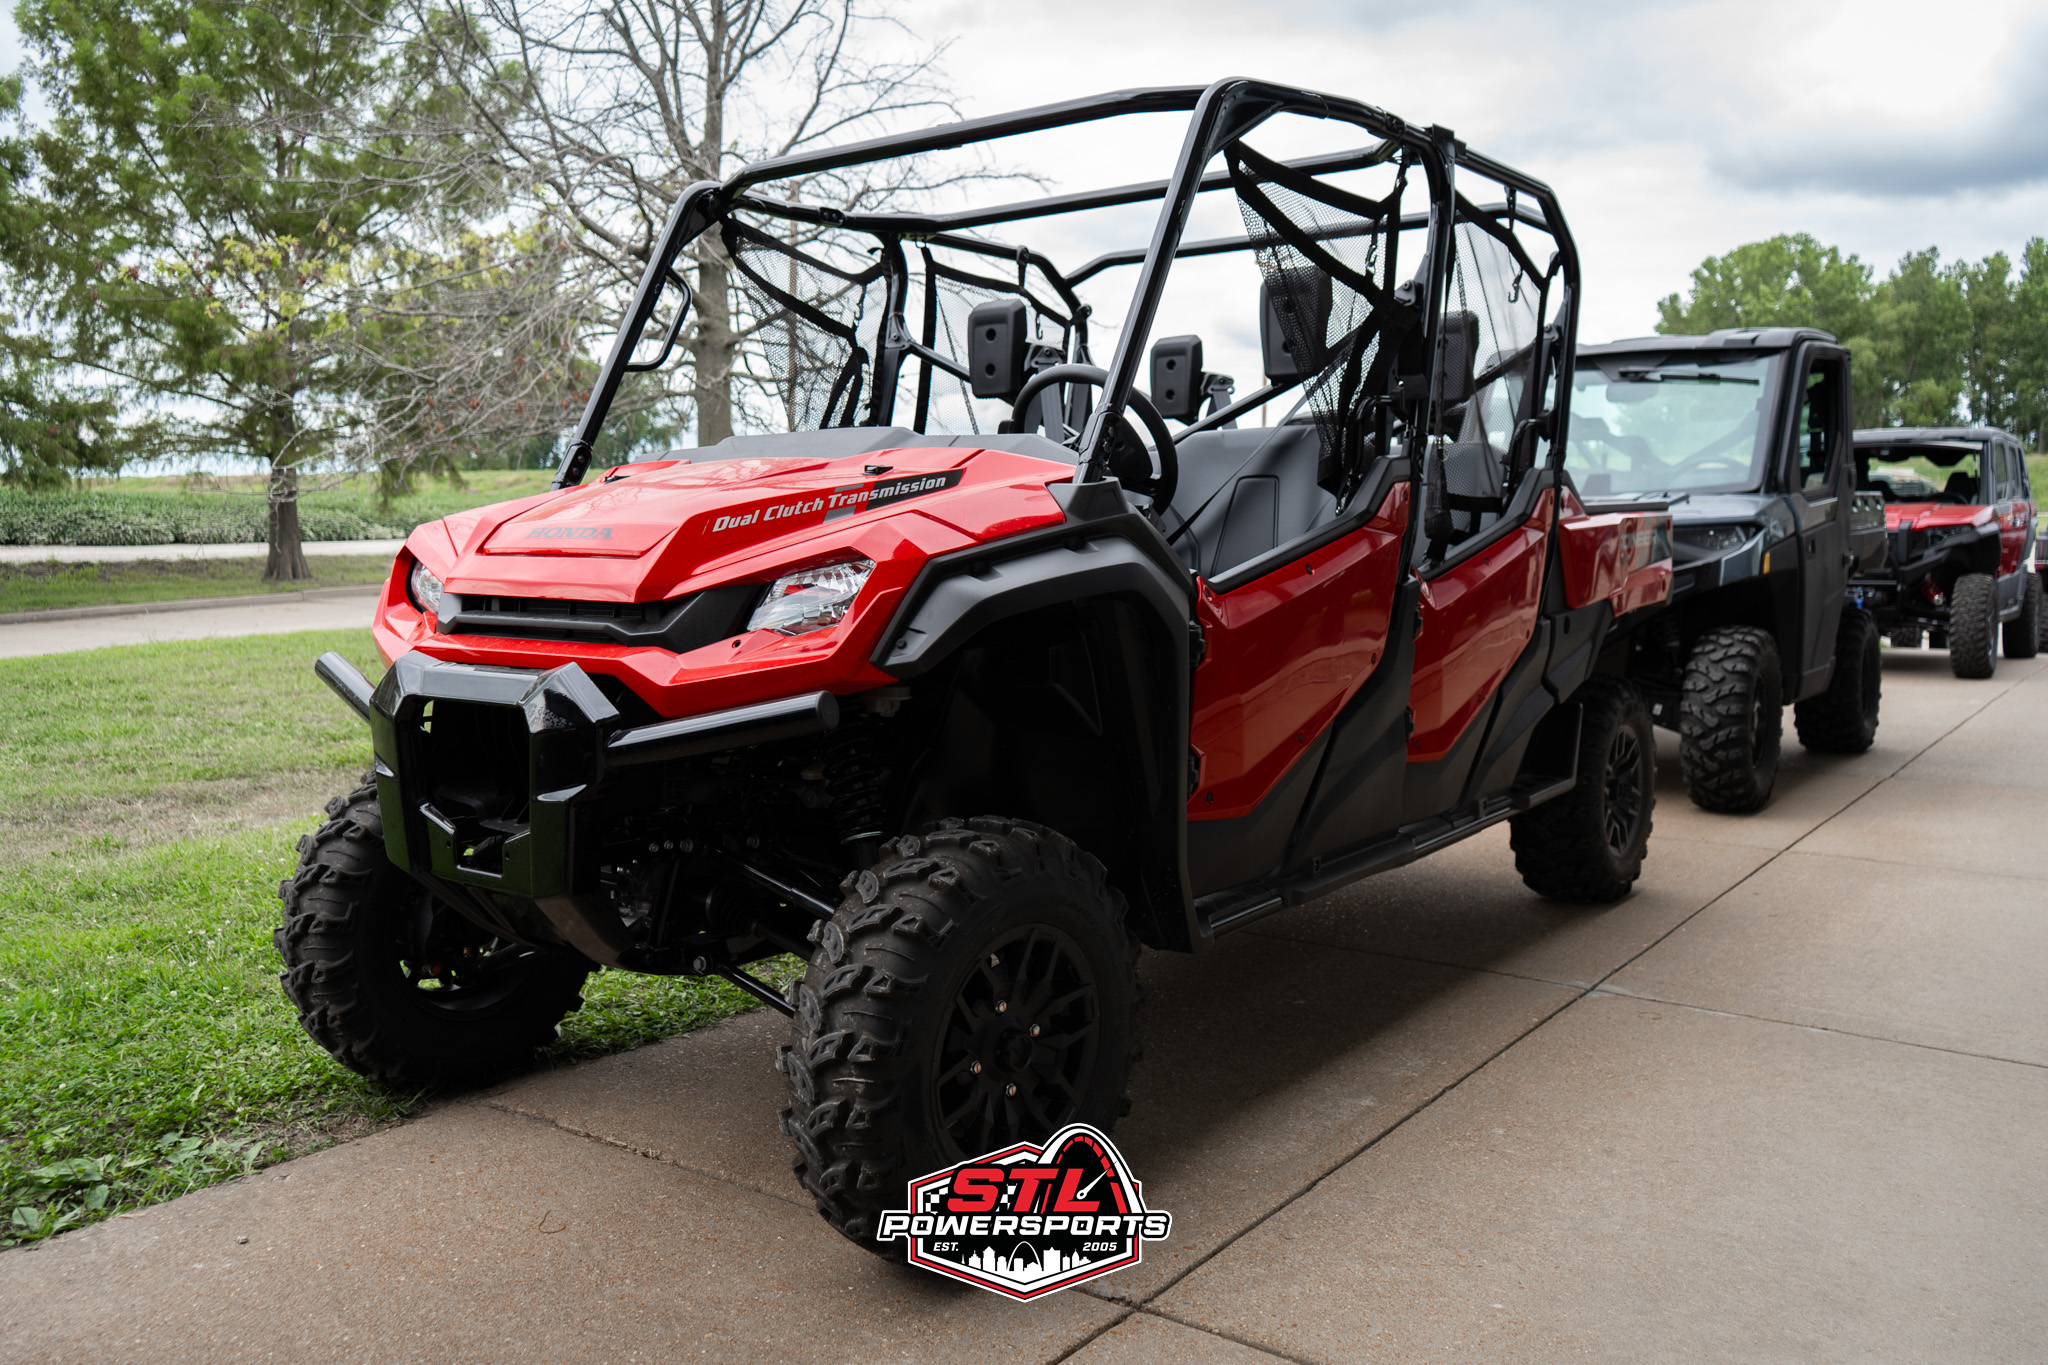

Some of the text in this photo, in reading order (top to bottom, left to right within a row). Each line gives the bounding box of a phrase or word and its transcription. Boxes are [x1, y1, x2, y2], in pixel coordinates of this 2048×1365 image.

[712, 476, 947, 533] Dual Clutch Transmission
[525, 527, 613, 539] HONDA
